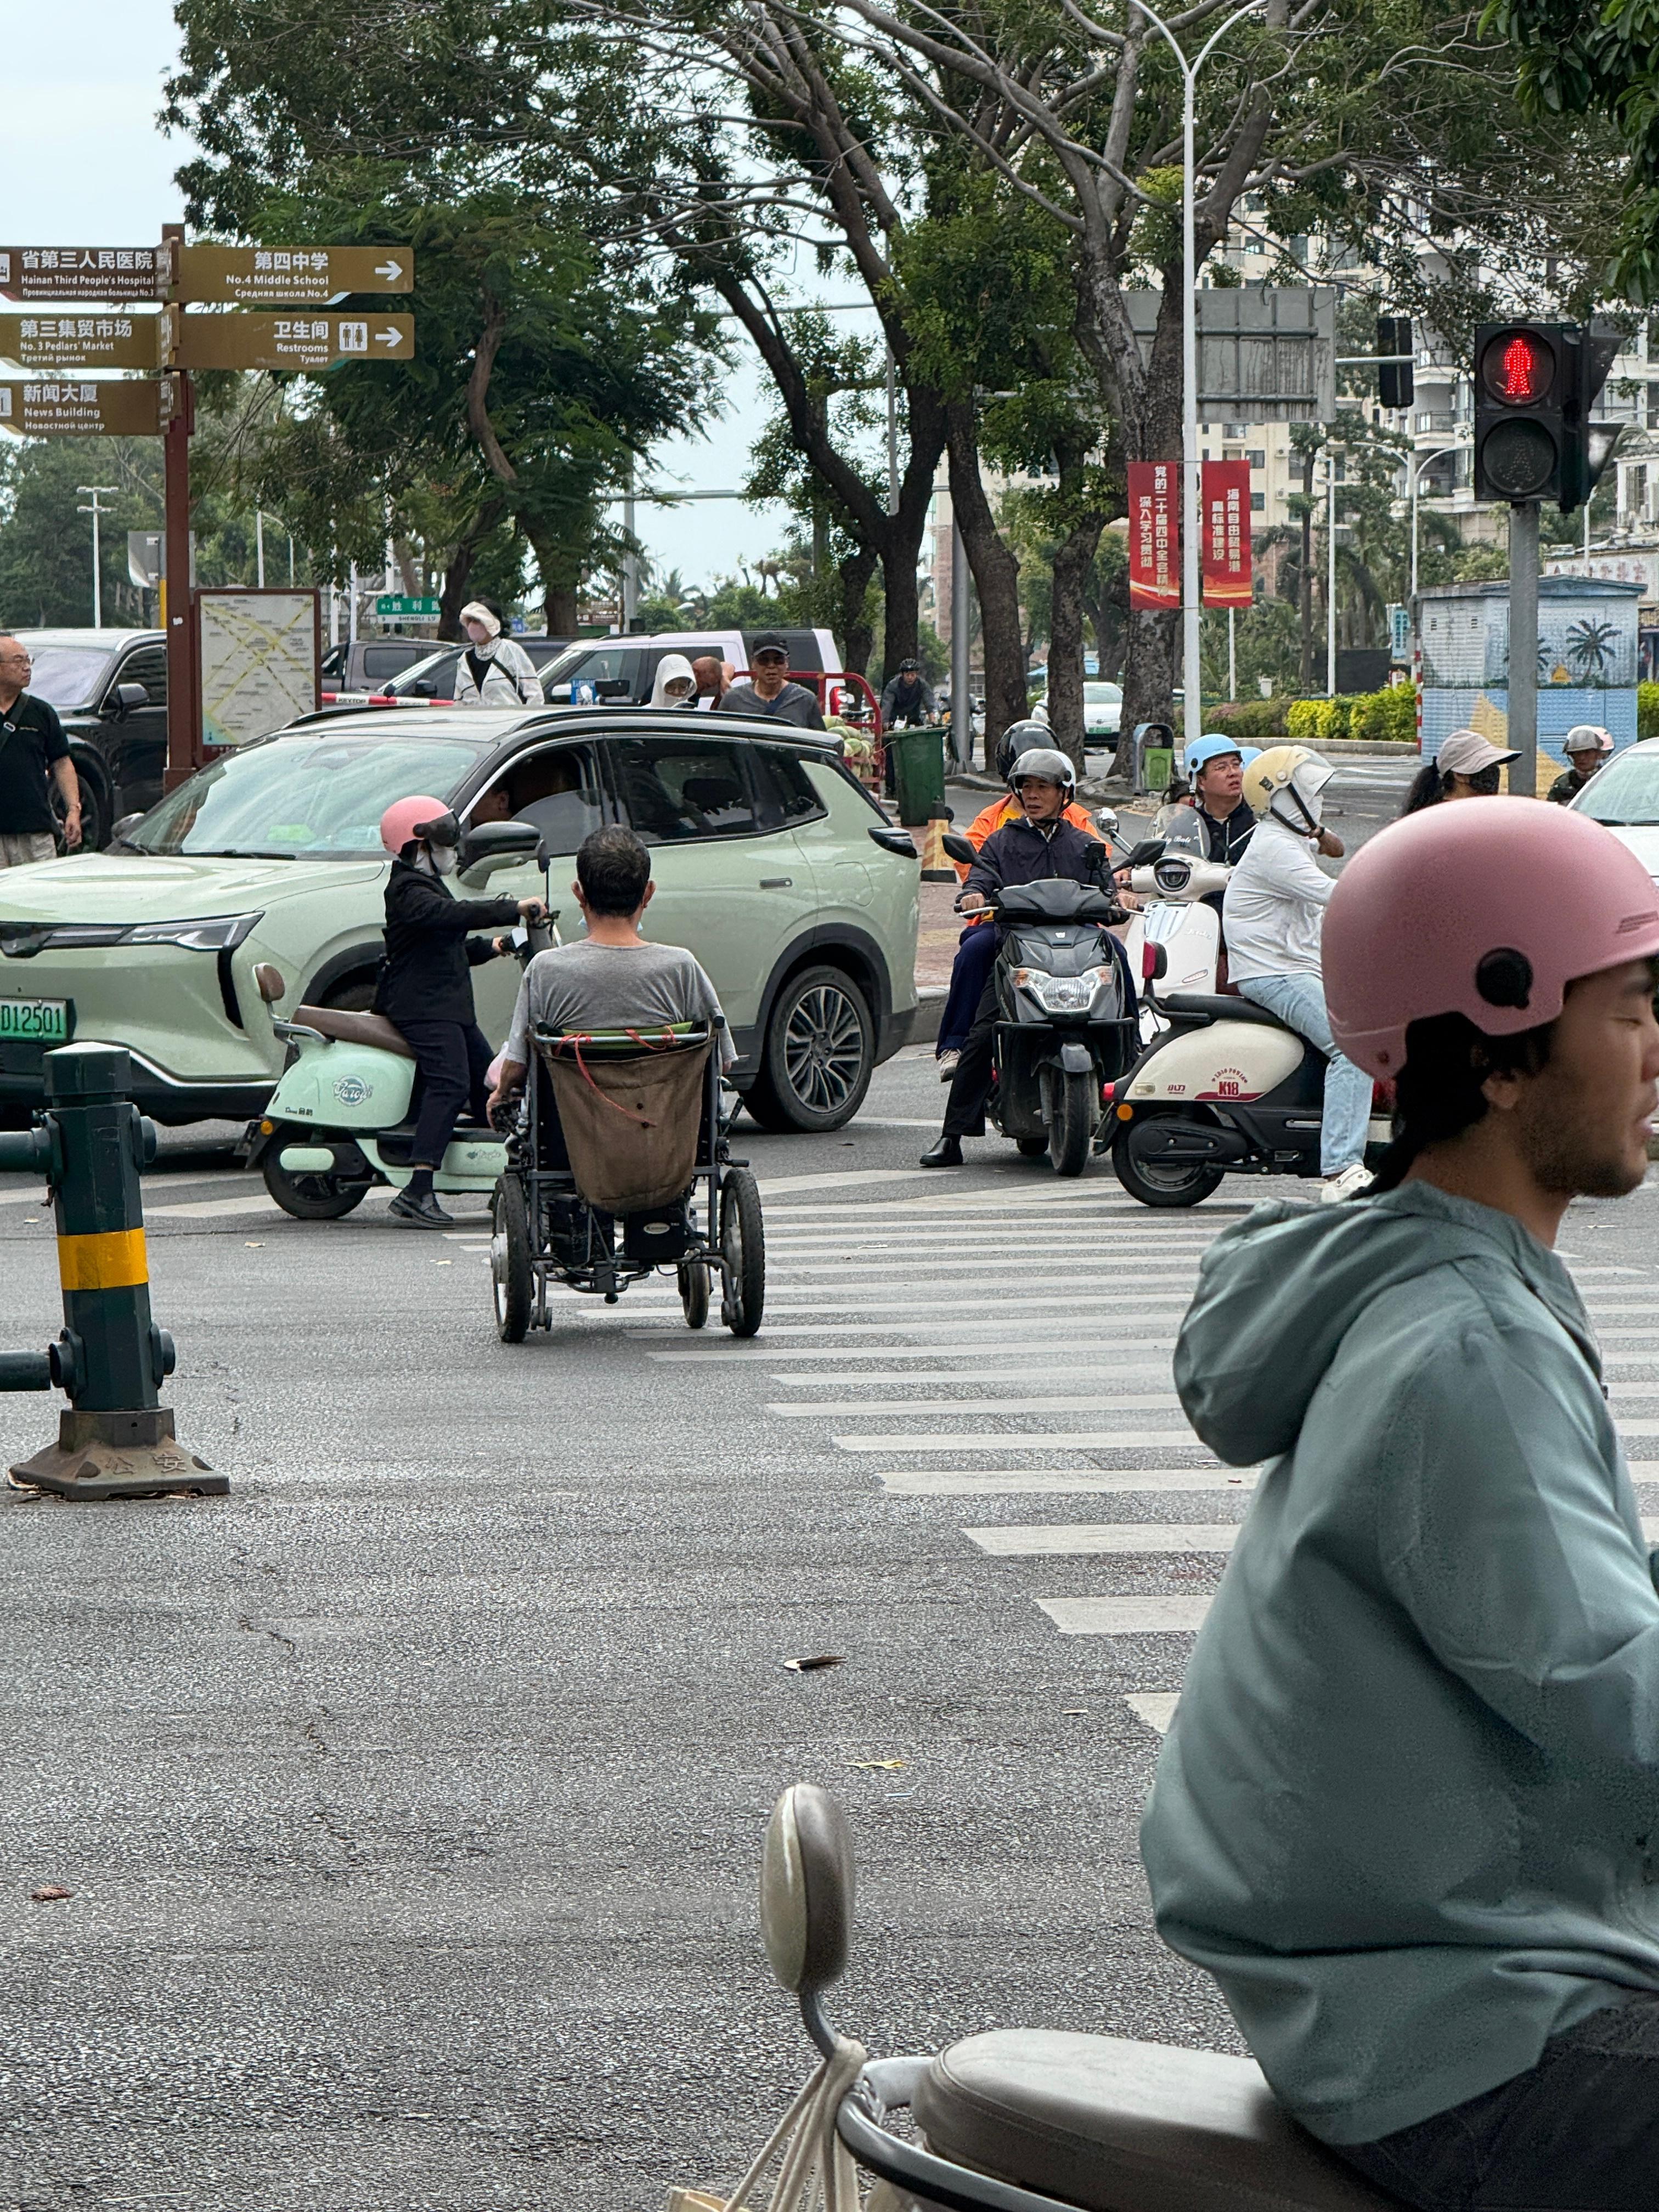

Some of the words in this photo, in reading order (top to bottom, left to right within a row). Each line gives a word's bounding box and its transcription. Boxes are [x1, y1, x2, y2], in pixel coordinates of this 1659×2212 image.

[21, 250, 153, 269] 省第三人民医院
[255, 251, 329, 270] 第四中学
[21, 275, 53, 285] Hainan
[55, 275, 77, 285] Third
[80, 275, 115, 286] People's
[118, 275, 154, 286] Hospital
[226, 274, 251, 284] No.4
[253, 274, 291, 285] Middle
[293, 275, 329, 285] School
[235, 289, 274, 298] Средняя
[307, 289, 329, 298] No.4
[20, 319, 132, 338] 第三集贸市场
[273, 320, 329, 339] 卫生间
[20, 341, 36, 351] No.
[38, 341, 43, 351] 3
[45, 341, 80, 351] Pedlars'
[82, 341, 114, 351] Market
[276, 343, 329, 353] Restrooms
[21, 354, 54, 362] Третий
[55, 355, 86, 363] рынок
[300, 354, 328, 364] Туалет
[23, 384, 98, 402] 新闻大厦
[24, 408, 53, 417] News
[55, 408, 100, 419] Building
[25, 421, 76, 430] Новостной
[77, 422, 105, 431] центр
[1226, 488, 1241, 573] 海南自由贸易港
[1, 1005, 62, 1034] D12501
[1219, 1081, 1239, 1096] K18
[105, 1453, 187, 1476] 公安
